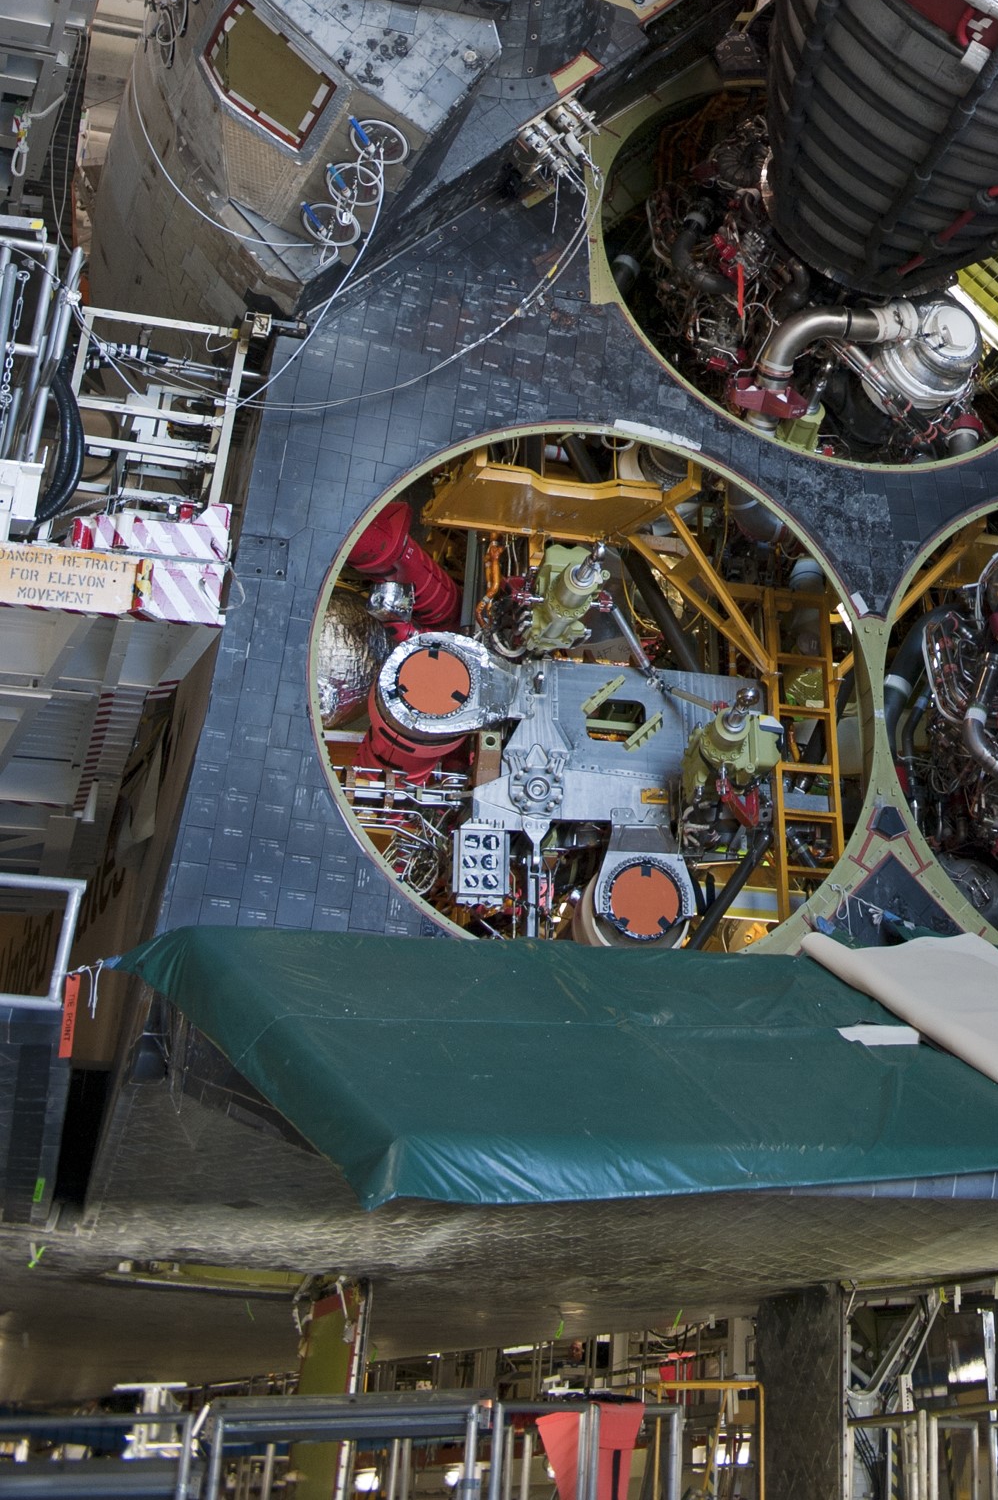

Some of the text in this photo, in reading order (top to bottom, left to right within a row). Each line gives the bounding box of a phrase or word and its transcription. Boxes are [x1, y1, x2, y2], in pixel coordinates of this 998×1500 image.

[62, 555, 129, 573] RETRACT
[10, 567, 105, 588] FOR ELEVON
[17, 586, 93, 605] MOVEMENT
[63, 1012, 74, 1042] POINT
